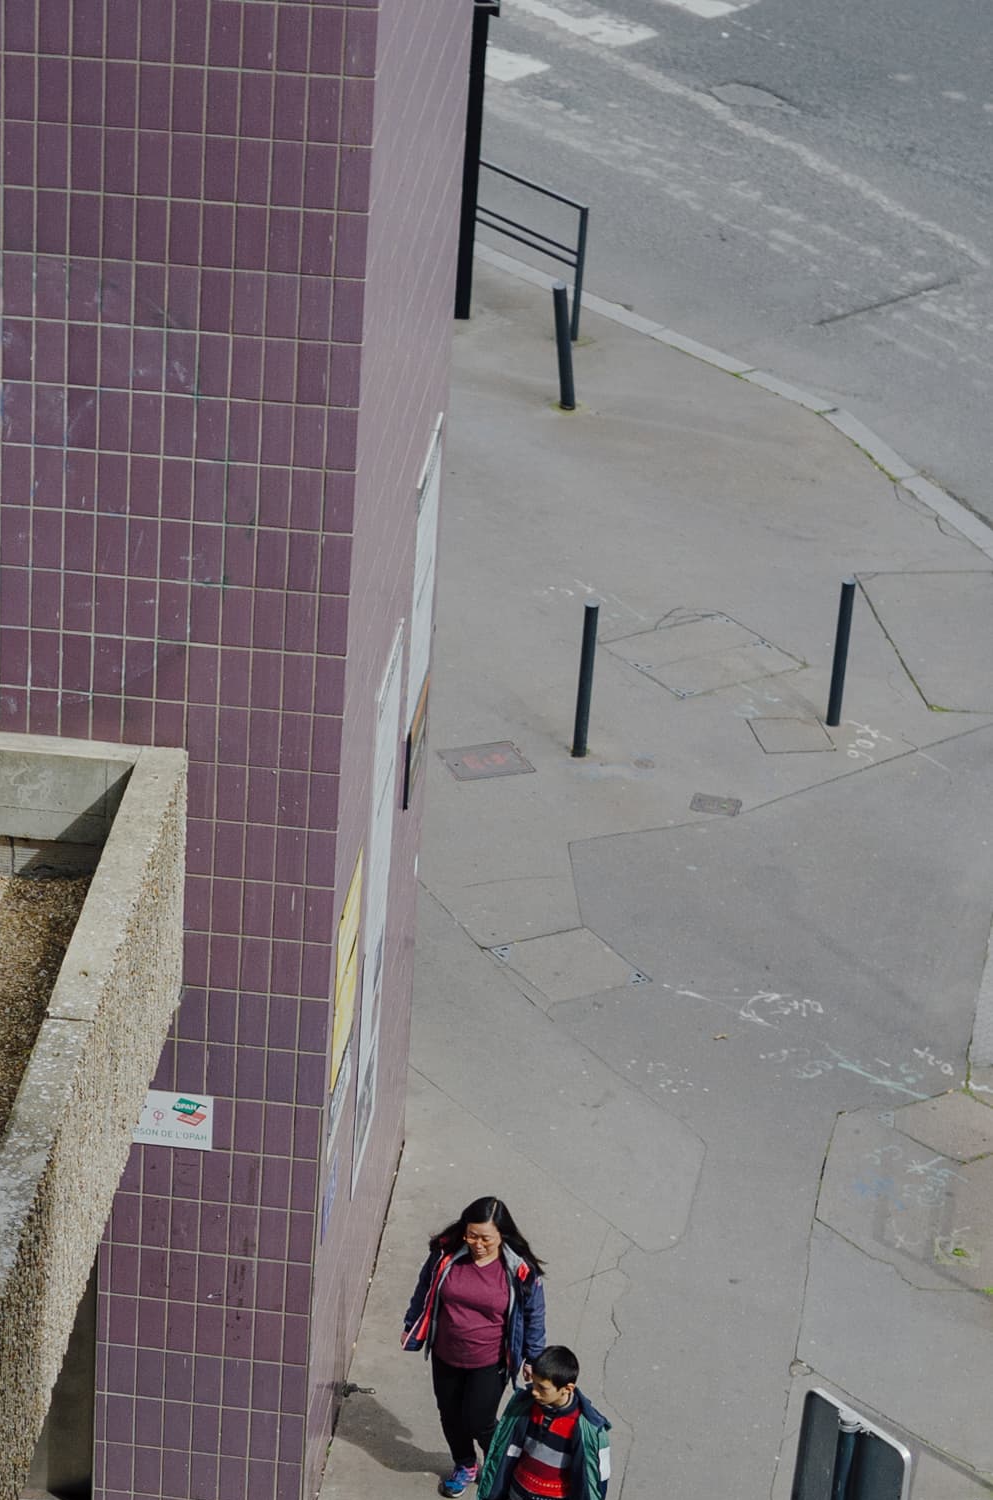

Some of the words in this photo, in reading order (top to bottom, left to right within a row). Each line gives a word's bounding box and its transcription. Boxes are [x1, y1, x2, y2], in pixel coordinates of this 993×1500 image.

[175, 1103, 198, 1112] OPAH
[161, 1130, 173, 1138] DE
[176, 1131, 207, 1142] L'OPAH
